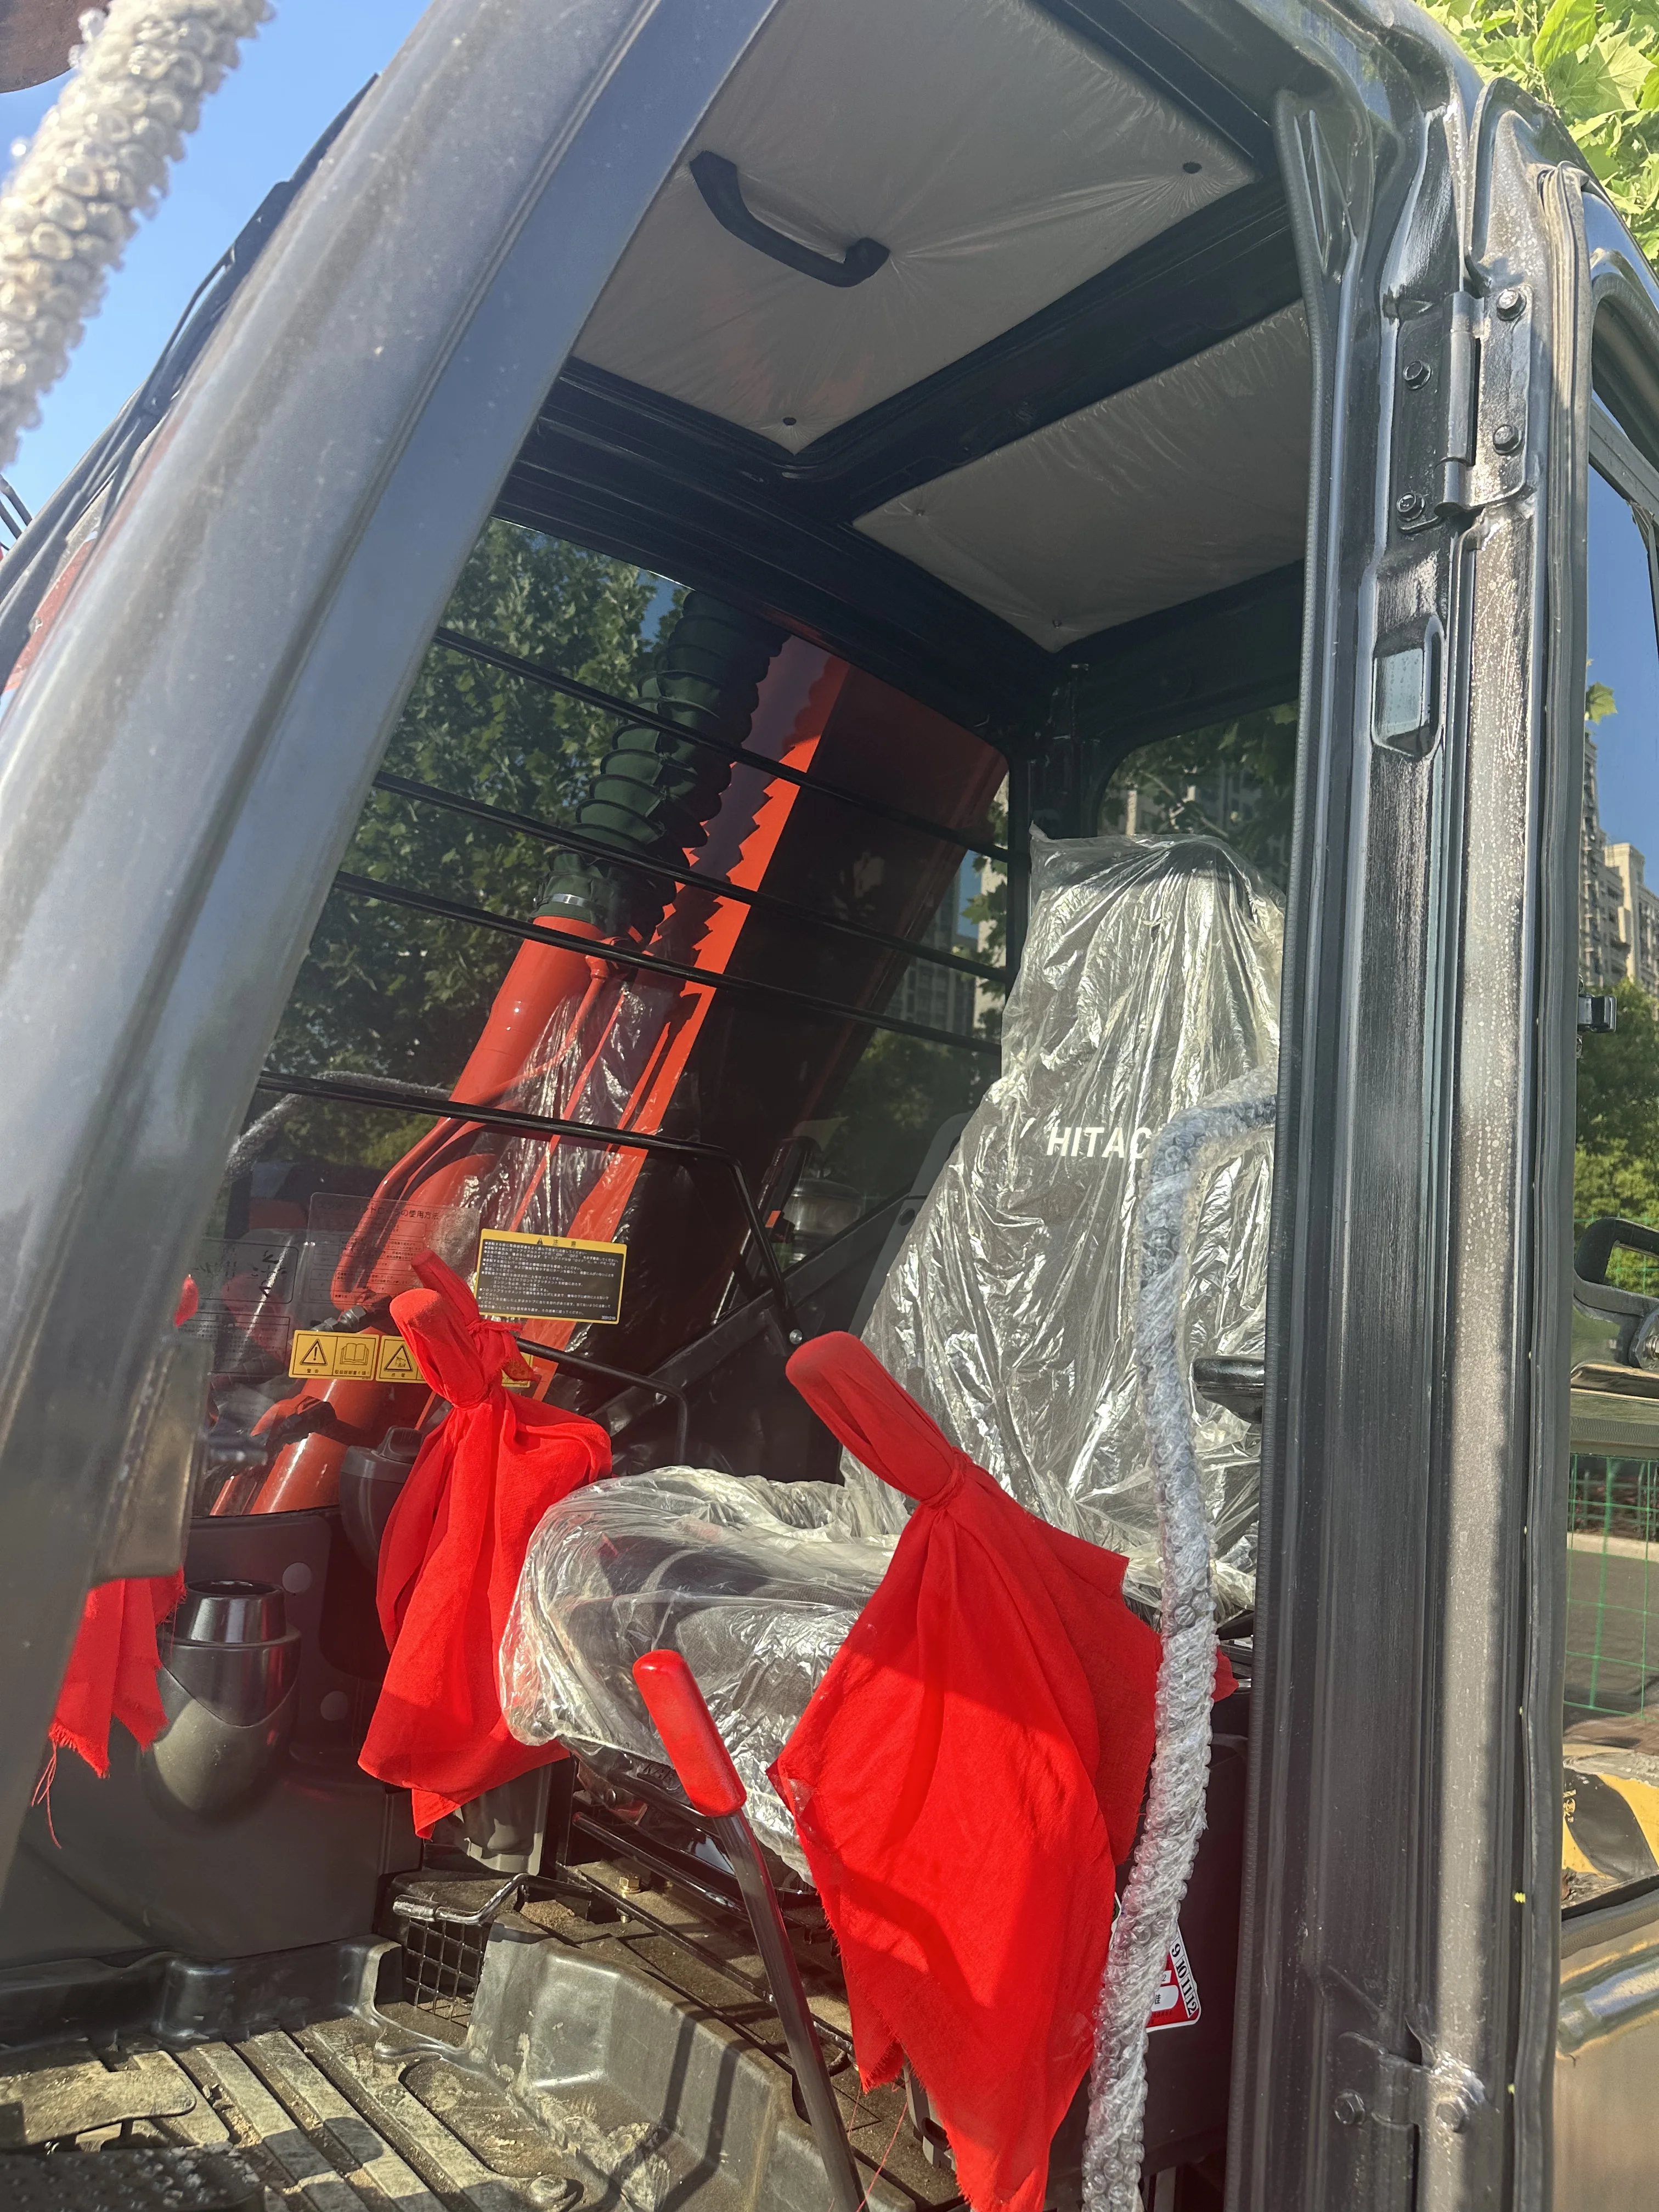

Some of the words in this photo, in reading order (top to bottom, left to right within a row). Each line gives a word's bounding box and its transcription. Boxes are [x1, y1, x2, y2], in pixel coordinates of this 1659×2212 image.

[1047, 1126, 1152, 1158] HITAC
[1171, 1943, 1181, 1957] 9
[1175, 1958, 1187, 1978] 10
[1181, 1977, 1193, 1999] 11
[1186, 1994, 1197, 2016] 12
